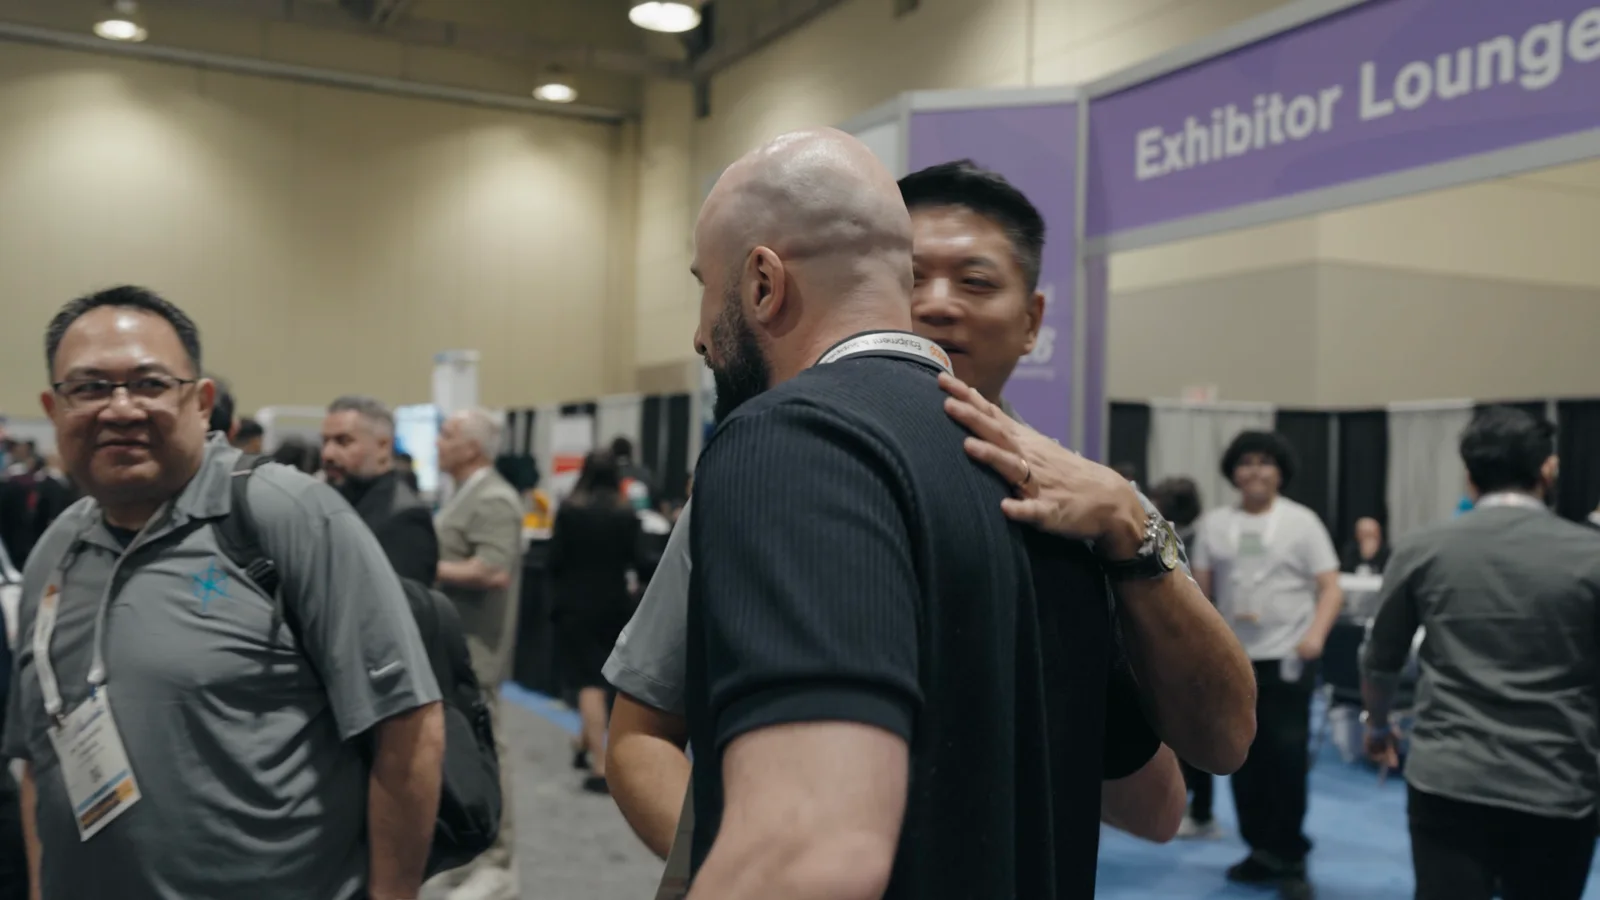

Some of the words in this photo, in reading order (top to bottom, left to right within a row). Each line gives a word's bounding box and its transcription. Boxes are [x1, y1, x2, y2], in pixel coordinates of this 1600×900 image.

[1135, 84, 1342, 180] Exhibitor
[1359, 7, 1600, 120] Lounge
[872, 336, 922, 351] Equipment
